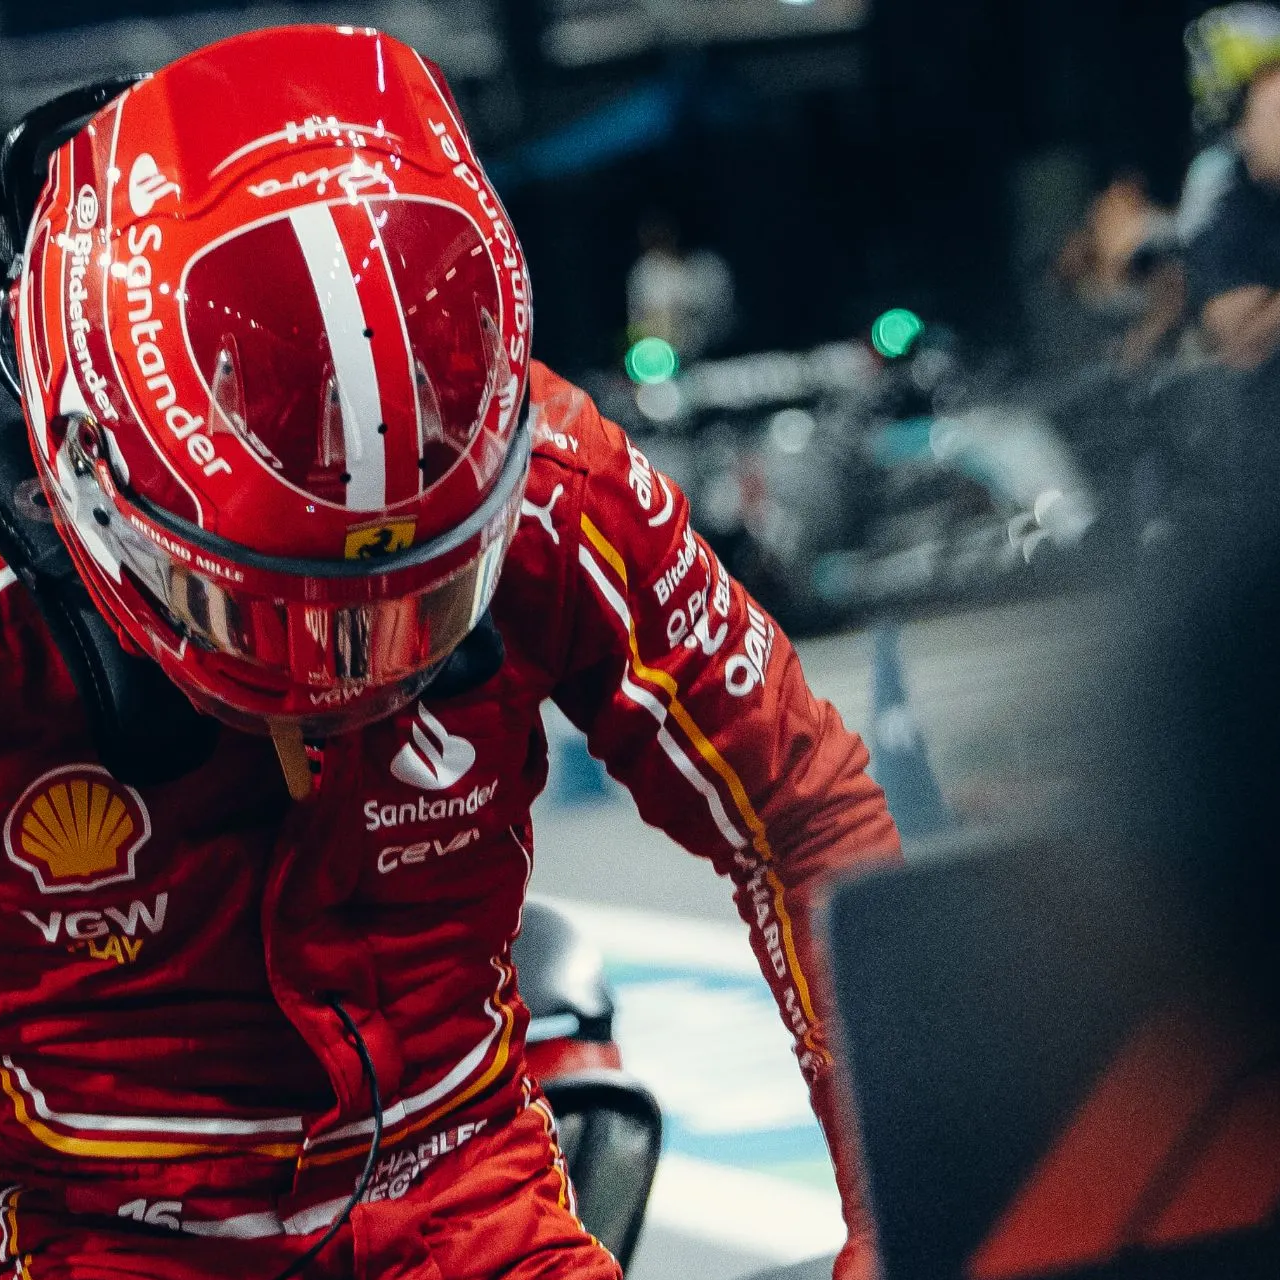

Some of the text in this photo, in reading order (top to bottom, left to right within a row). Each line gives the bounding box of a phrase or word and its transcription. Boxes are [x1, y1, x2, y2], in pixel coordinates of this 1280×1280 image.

[427, 117, 526, 366] Santander
[70, 232, 119, 420] Bitdefender
[126, 223, 233, 478] Santander
[363, 778, 499, 832] Santander
[20, 891, 169, 944] VGW
[67, 933, 144, 965] LAY
